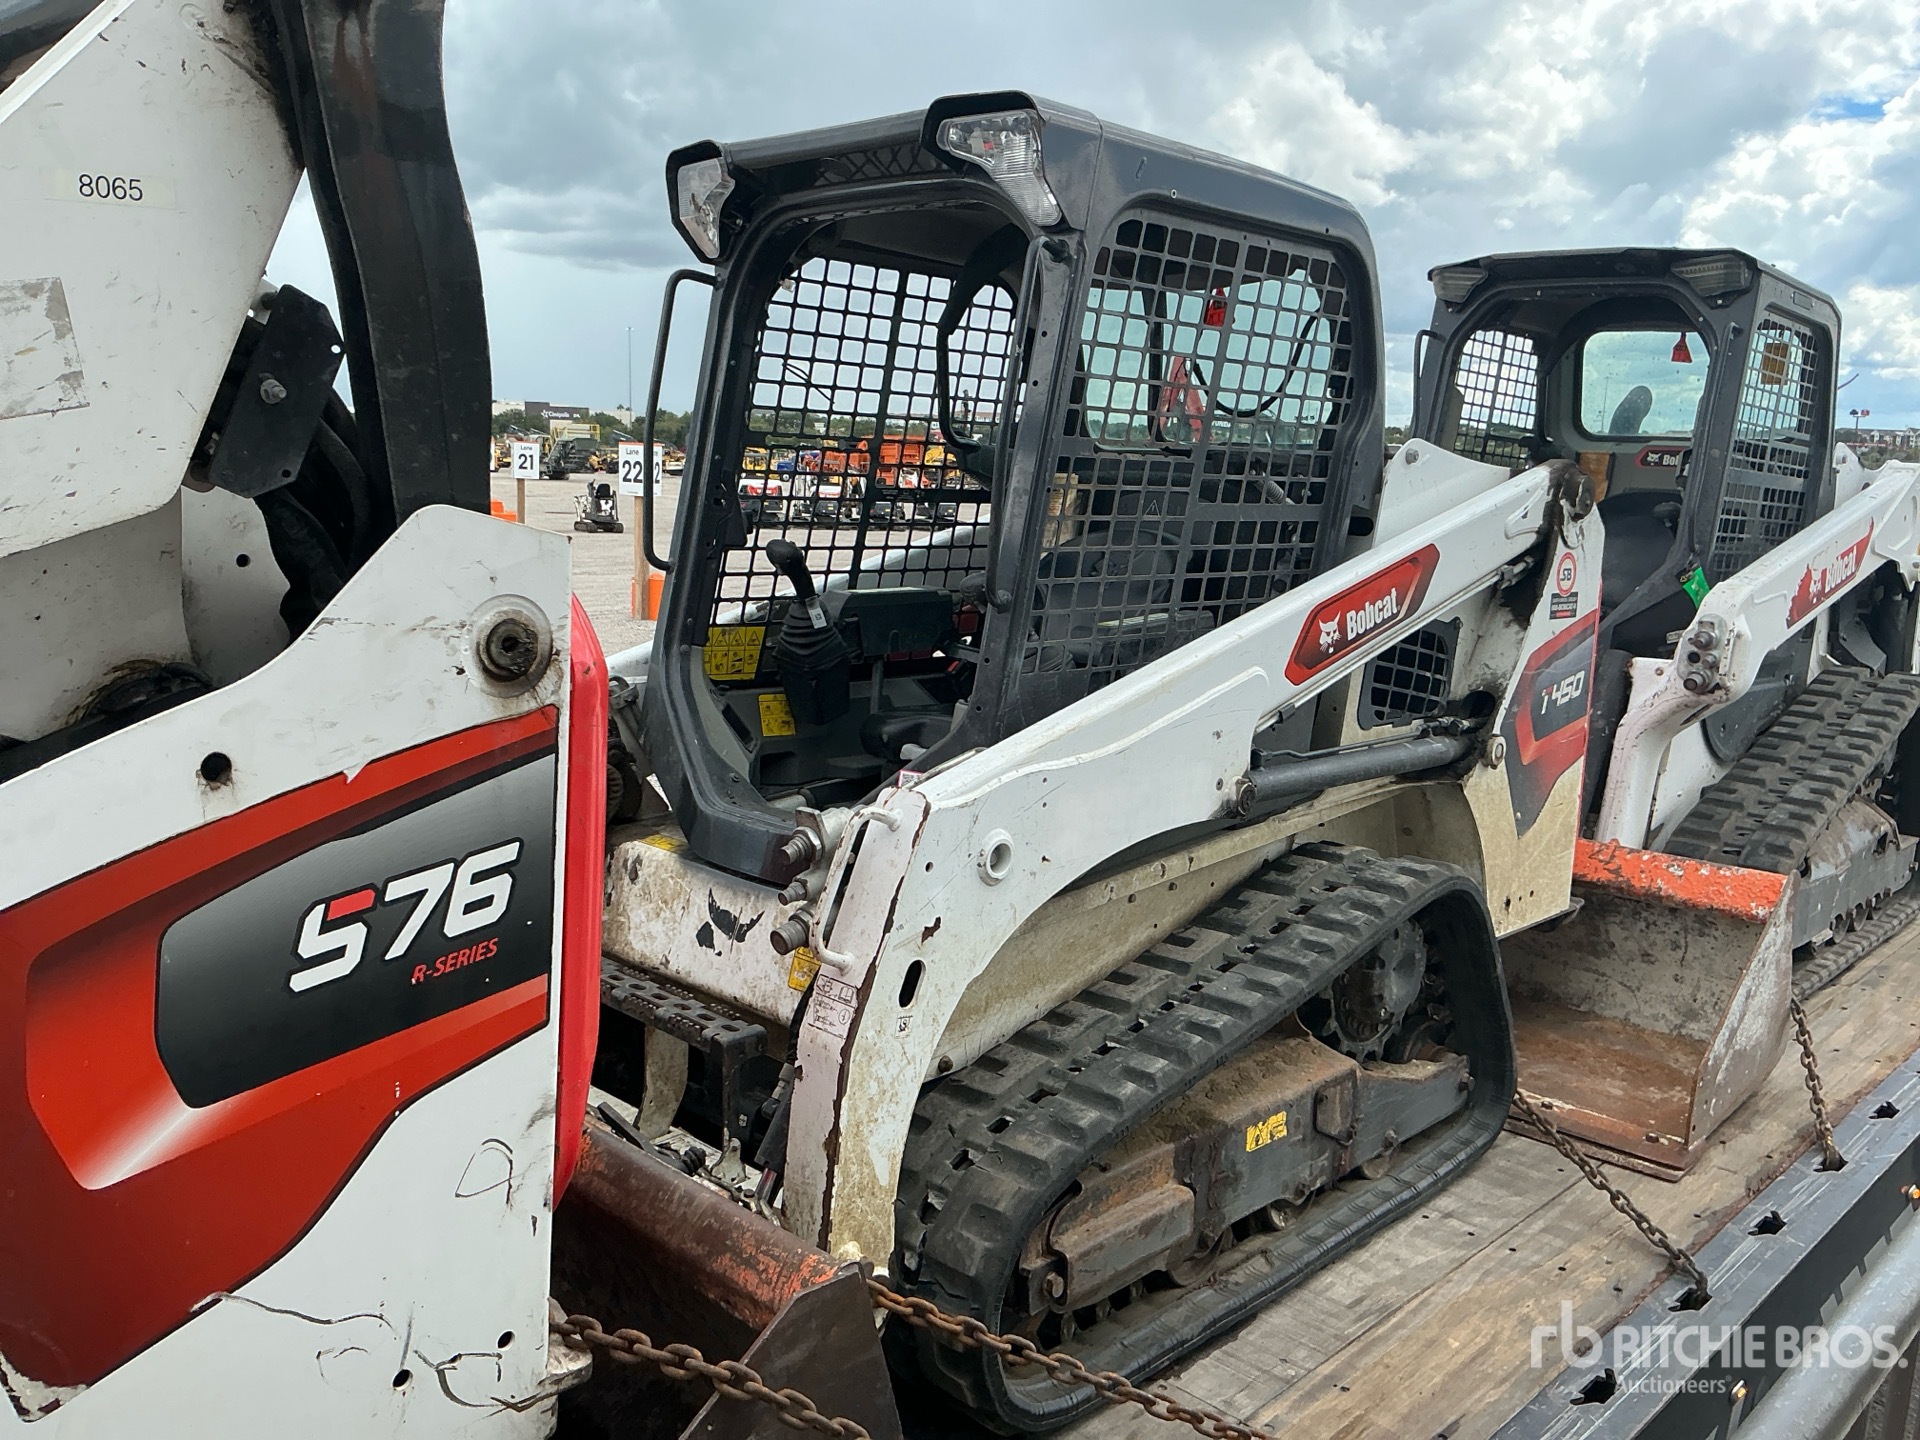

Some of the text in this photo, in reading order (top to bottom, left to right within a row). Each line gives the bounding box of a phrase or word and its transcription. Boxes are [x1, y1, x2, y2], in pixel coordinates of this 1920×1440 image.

[78, 173, 144, 202] 8065
[518, 453, 534, 470] 21
[625, 448, 640, 456] Lane
[621, 460, 643, 483] 22
[1346, 587, 1399, 642] Bobcat
[1541, 670, 1586, 715] T450
[288, 841, 521, 993] S76
[412, 937, 499, 984] R-SERIES
